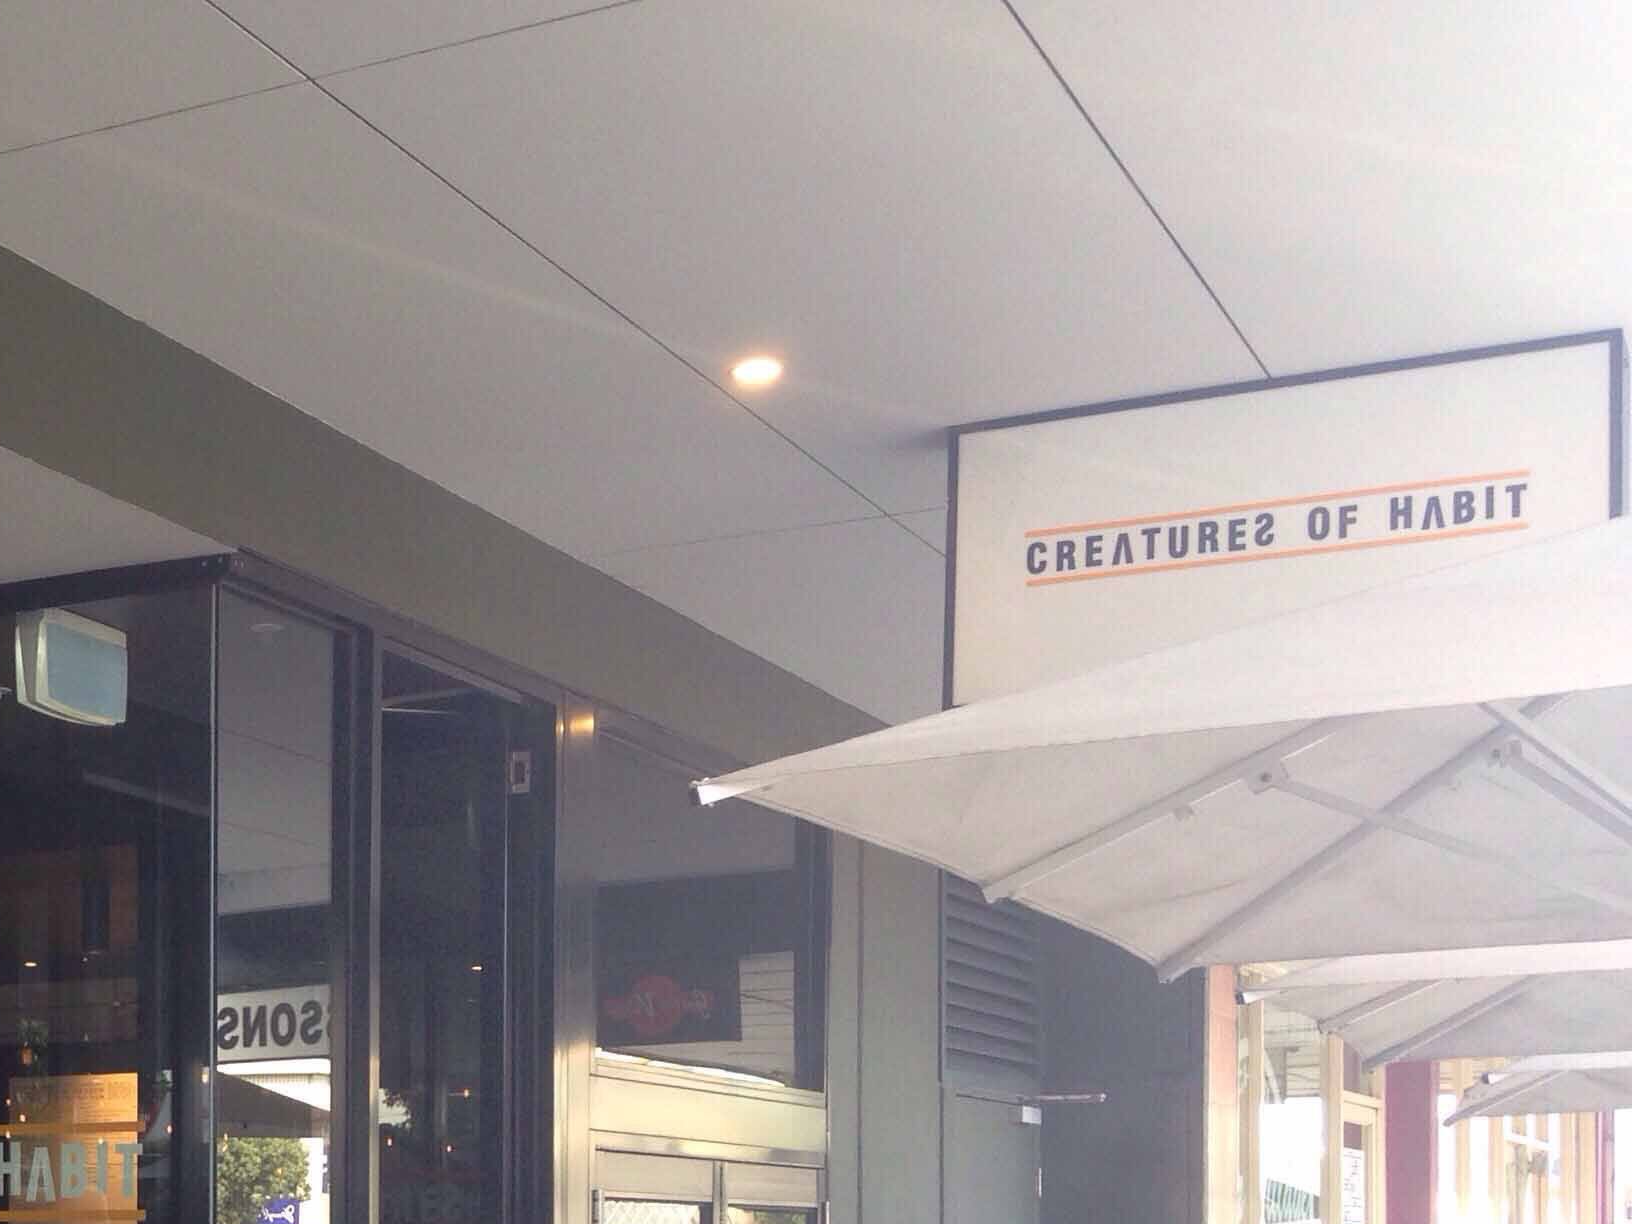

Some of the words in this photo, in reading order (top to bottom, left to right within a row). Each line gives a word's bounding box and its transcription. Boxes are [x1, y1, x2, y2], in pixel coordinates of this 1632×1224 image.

[1025, 511, 1275, 576] CREATURES
[1306, 503, 1358, 541] OF
[1389, 483, 1528, 531] HABIT
